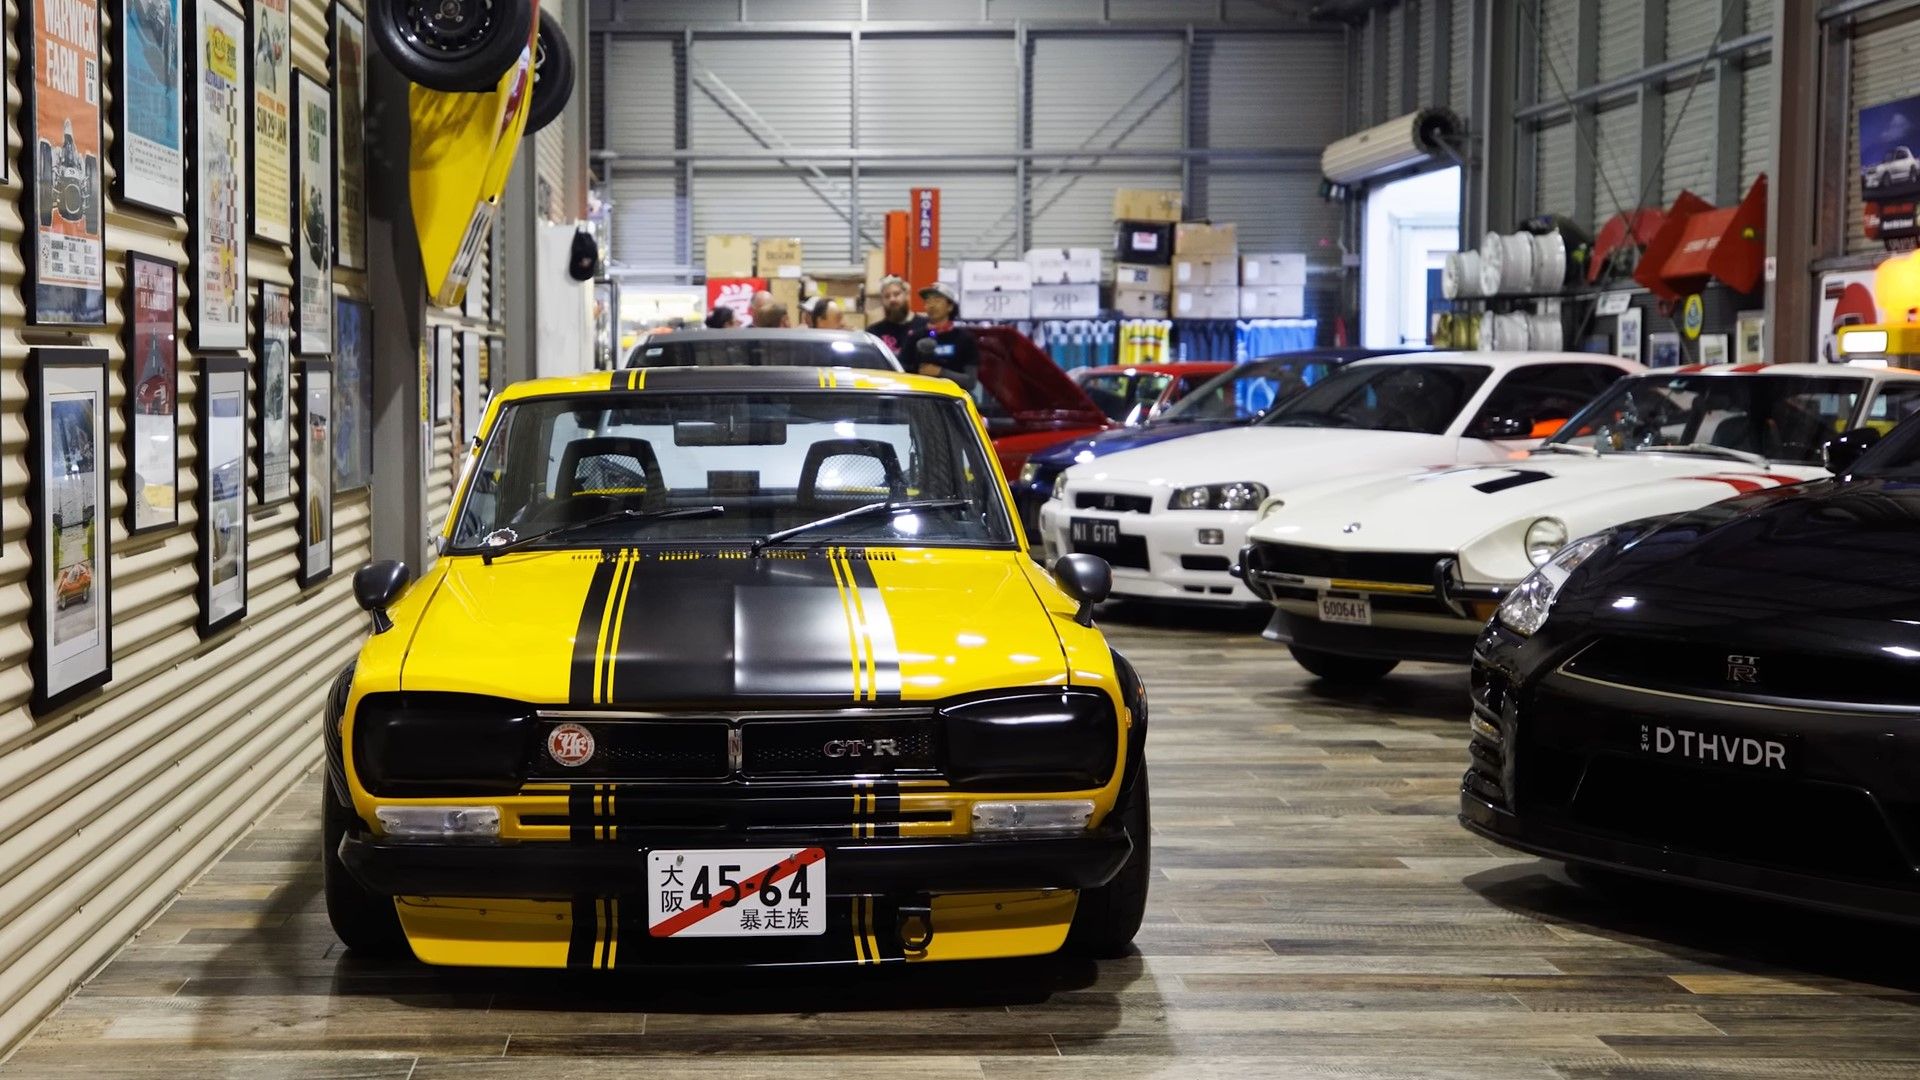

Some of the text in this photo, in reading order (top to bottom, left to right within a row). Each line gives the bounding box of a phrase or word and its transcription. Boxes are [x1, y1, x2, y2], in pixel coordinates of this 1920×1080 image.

[46, 39, 79, 98] FARM
[920, 190, 932, 247] MOLNAR
[1093, 524, 1117, 544] GTR
[823, 738, 900, 758] GT-R
[1640, 725, 1650, 751] NSW
[1656, 727, 1786, 770] DTHVDR
[660, 864, 685, 913] 大阪
[740, 908, 809, 931] 暴走族
